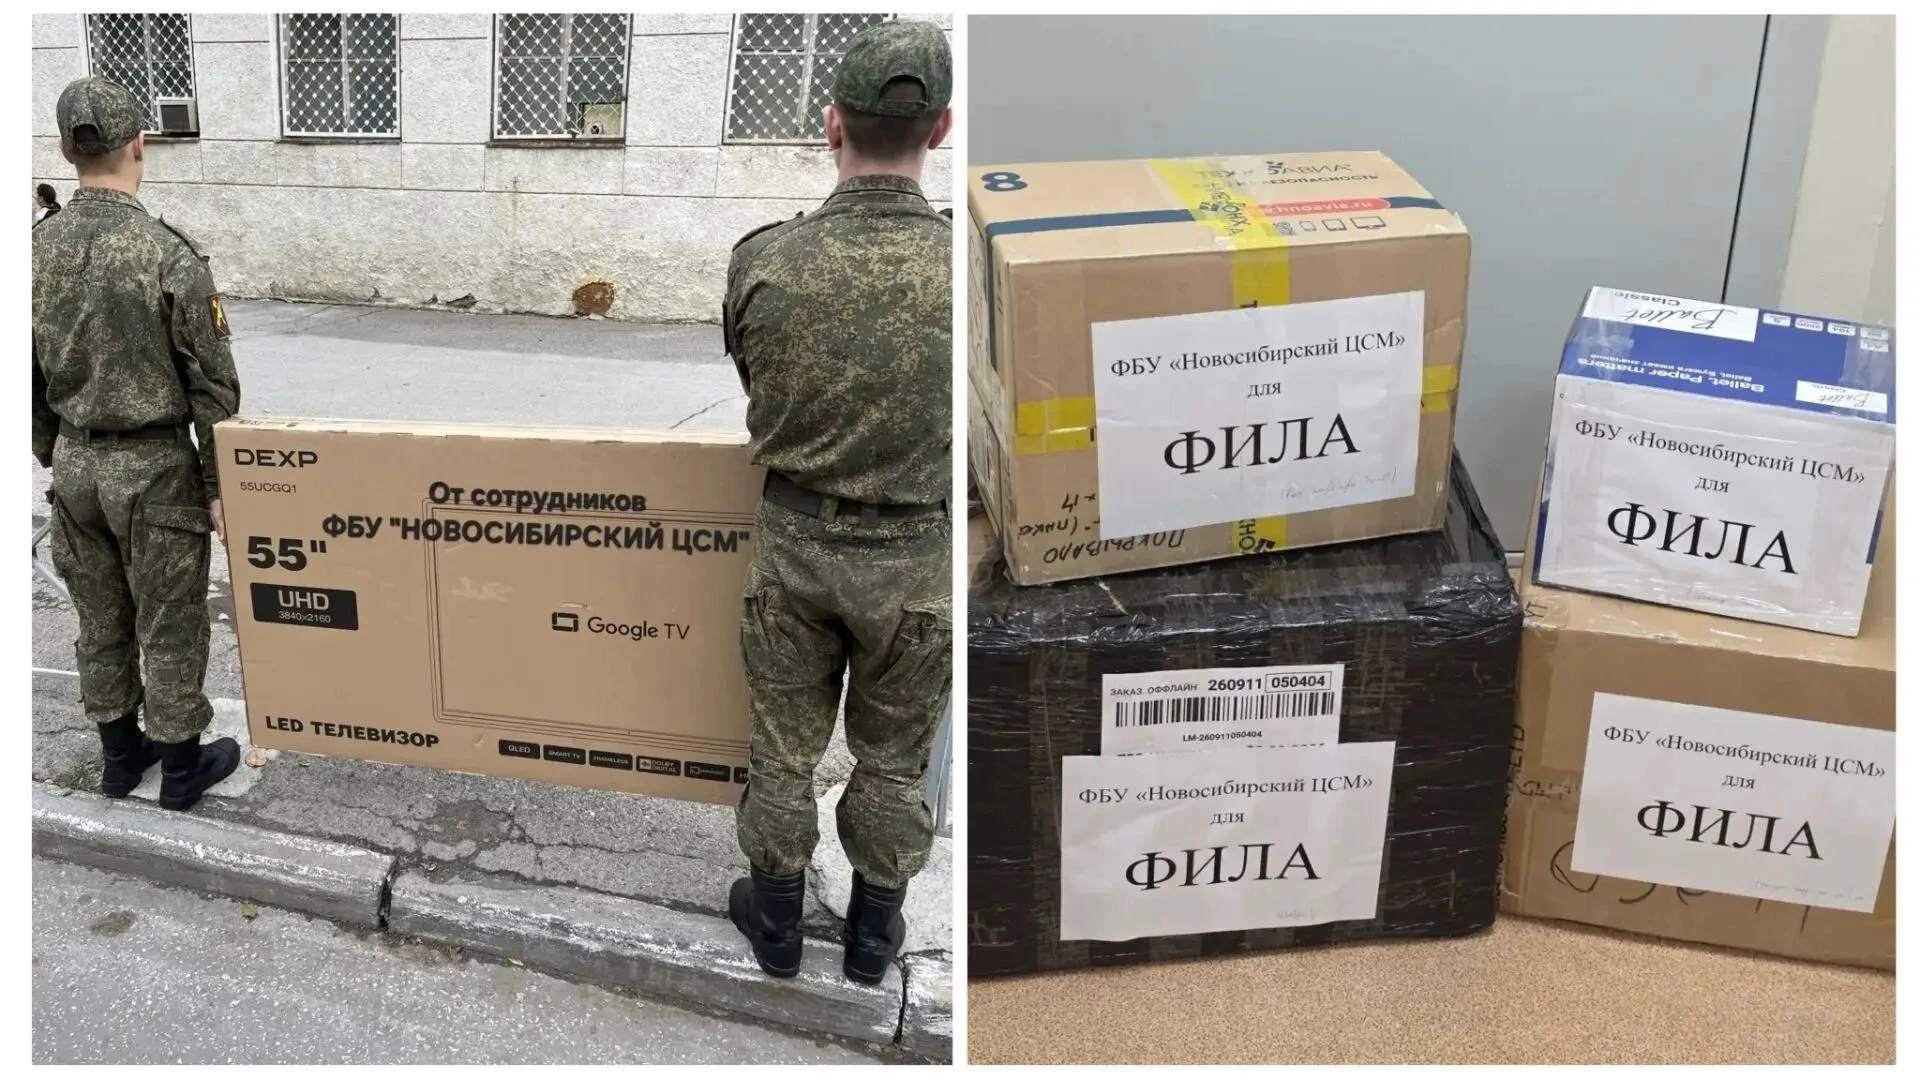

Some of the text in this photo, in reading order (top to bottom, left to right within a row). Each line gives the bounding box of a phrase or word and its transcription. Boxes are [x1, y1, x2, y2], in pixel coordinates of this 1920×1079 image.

[980, 171, 1028, 192] 8
[1614, 290, 1681, 307] Classic
[1623, 308, 1738, 331] Ballet
[1110, 330, 1407, 378] ФБУ «Новосибирский ЦСМ»
[1577, 357, 1766, 393] Ballet. Paper matters
[1246, 379, 1282, 400] для
[1163, 412, 1361, 477] ФИЛА
[1574, 419, 1866, 485] ФБУ «Новосибирский ЦСМ»
[233, 448, 319, 469] DEXP
[240, 481, 298, 494] 55UCGQ1
[1694, 475, 1730, 494] для
[428, 481, 648, 514] От сотрудников
[321, 513, 751, 556] ФБУ "НОВОСИБИРСКИЙ ЦСМ"
[1606, 500, 1799, 576] ФИЛА
[247, 536, 328, 572] 55"
[278, 590, 330, 612] UHD
[587, 616, 692, 642] Google TV
[1147, 683, 1198, 695] ОФФЛАЙН
[1208, 675, 1327, 692] 260911 050404
[265, 715, 440, 749] LED ТЕЛЕВИЗОР
[1182, 730, 1263, 743] LM-260911050404
[508, 744, 532, 755] QLED
[1603, 725, 1886, 779] ФБУ «Новосибирский ЦСМ»
[1078, 773, 1374, 804] ФБУ «Новосибирский ЦСМ»
[1721, 773, 1756, 791] для
[1209, 811, 1245, 826] для
[1636, 799, 1824, 861] ФИЛА
[1124, 842, 1322, 892] ФИЛА
